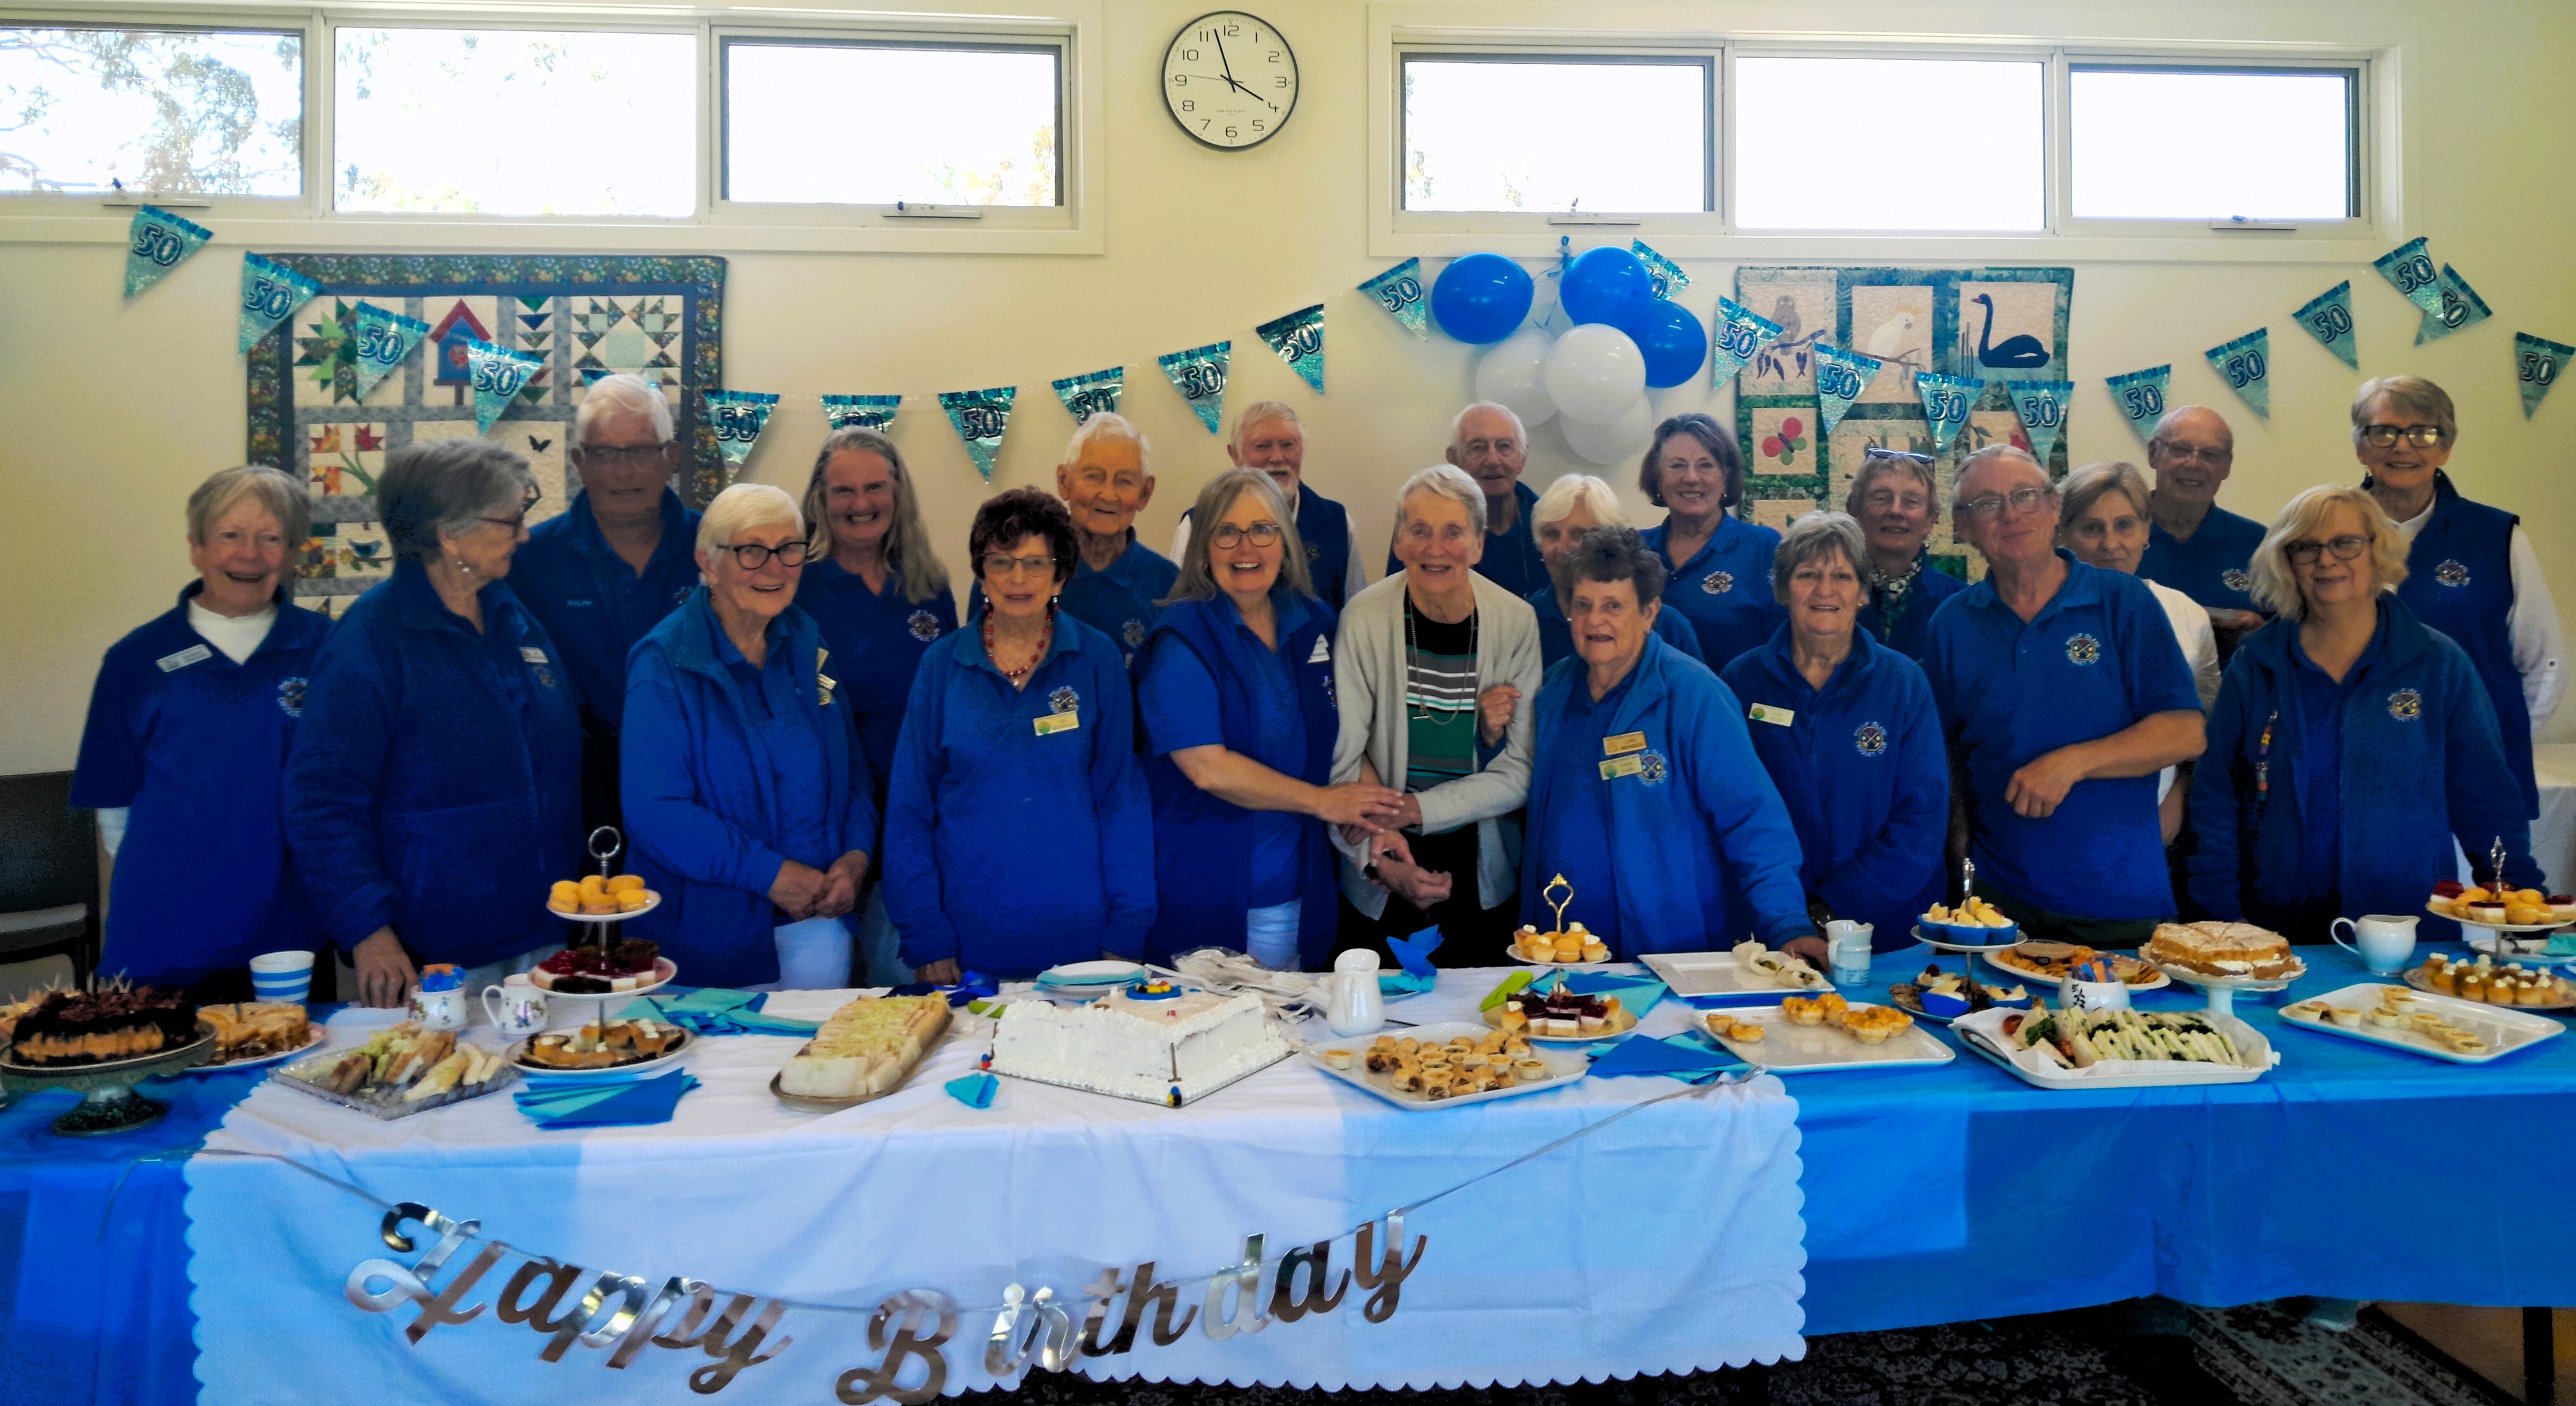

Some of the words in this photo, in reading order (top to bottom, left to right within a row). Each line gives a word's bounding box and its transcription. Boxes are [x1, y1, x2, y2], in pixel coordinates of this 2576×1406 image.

[1200, 31, 1208, 43] 11
[1224, 25, 1239, 37] 12
[1255, 32, 1257, 43] 1
[1182, 50, 1199, 61] 10
[1268, 51, 1280, 62] 2
[1175, 74, 1187, 86] 9
[1275, 76, 1287, 88] 3
[1182, 100, 1194, 111] 8
[1268, 102, 1279, 113] 4
[1200, 119, 1211, 130] 7
[1226, 126, 1238, 138] 6
[1252, 120, 1264, 131] 5
[133, 223, 182, 266] 50
[2395, 255, 2437, 294] 50
[245, 277, 292, 319] 50
[1378, 277, 1420, 312] 50
[1718, 319, 1758, 359] 50
[2313, 303, 2352, 344] 50
[358, 324, 404, 365] 50
[1278, 323, 1322, 362] 50
[473, 359, 521, 396] 50
[1180, 361, 1225, 399] 50
[1821, 363, 1860, 400] 50
[2228, 351, 2267, 388] 50
[2520, 351, 2556, 386] 50
[1930, 390, 1966, 424] 50
[2021, 396, 2059, 429] 50
[2124, 384, 2162, 419] 50
[717, 408, 759, 443] 50
[960, 405, 1004, 440] 50
[344, 1201, 793, 1395] Happy
[835, 1208, 1427, 1405] Birthday
